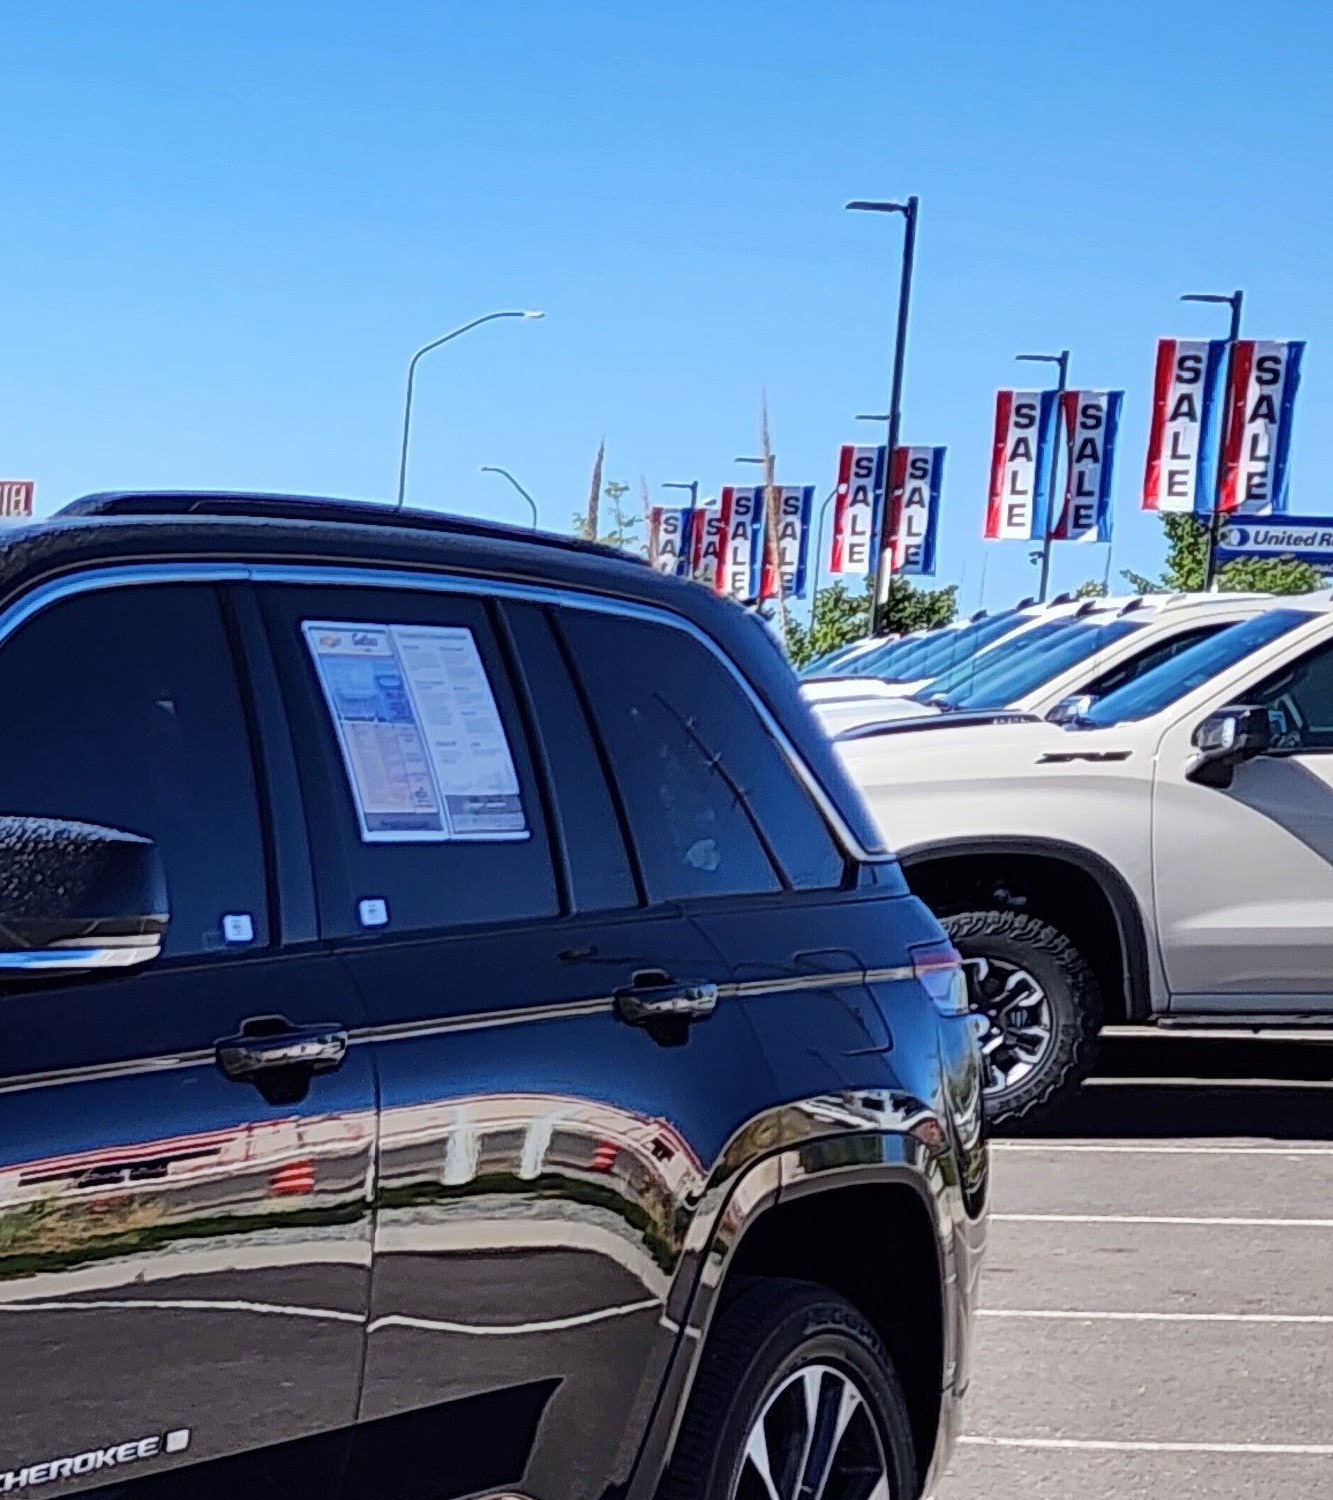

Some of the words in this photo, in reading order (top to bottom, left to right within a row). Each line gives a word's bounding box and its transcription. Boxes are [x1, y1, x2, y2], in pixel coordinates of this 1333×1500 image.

[1006, 403, 1037, 527] SALE
[1072, 403, 1104, 529] SALE
[1167, 355, 1203, 497] SALE
[1246, 355, 1282, 500] SALE
[703, 518, 722, 581] SAL
[731, 495, 752, 592] SALE
[779, 496, 800, 591] SALE
[848, 456, 874, 563] SALE
[904, 458, 929, 566] SALE
[1253, 530, 1318, 547] United
[1318, 532, 1333, 547] R
